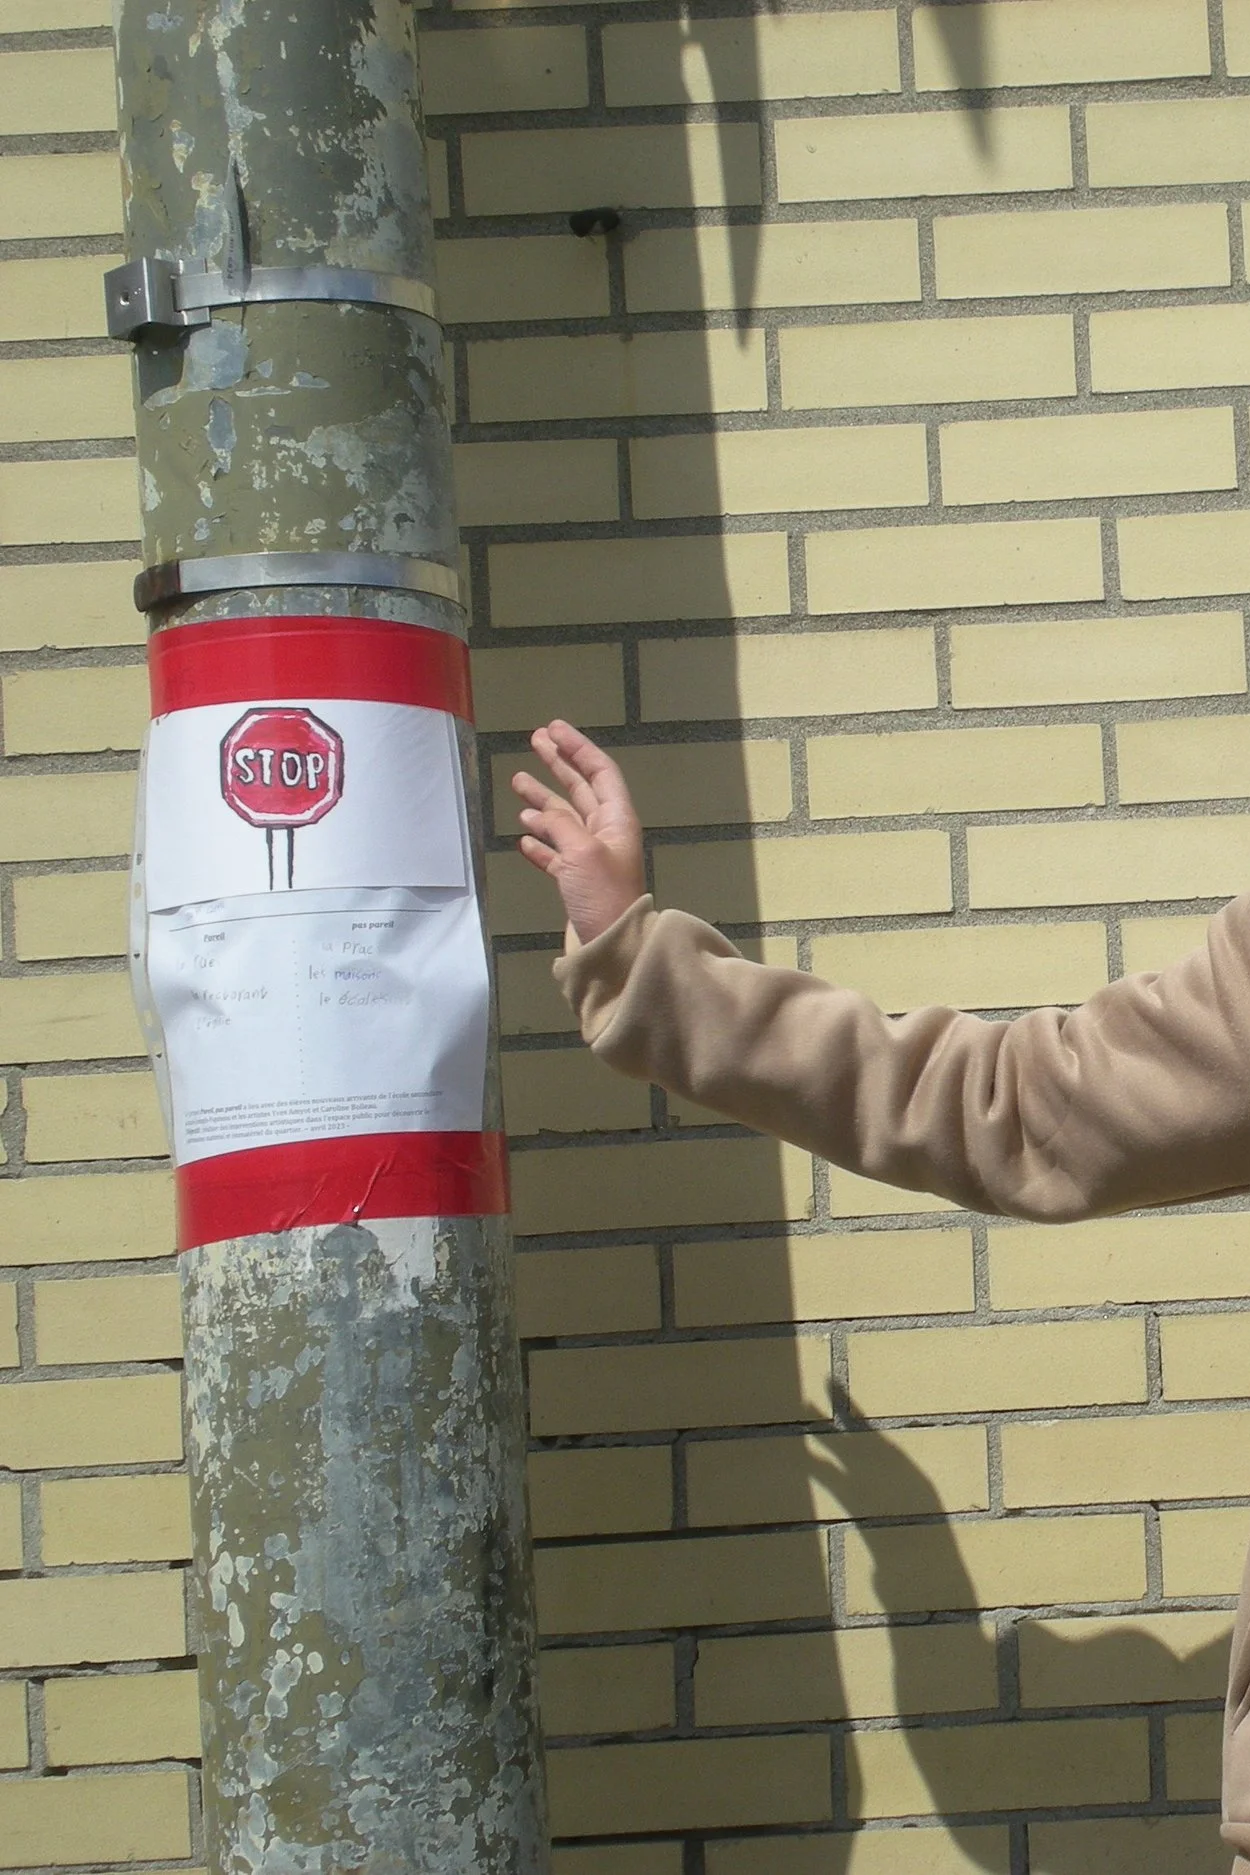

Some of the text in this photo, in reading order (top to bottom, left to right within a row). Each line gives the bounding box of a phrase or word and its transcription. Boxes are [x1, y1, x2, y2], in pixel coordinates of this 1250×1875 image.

[234, 747, 325, 790] STOP
[352, 920, 395, 931] pas pareil
